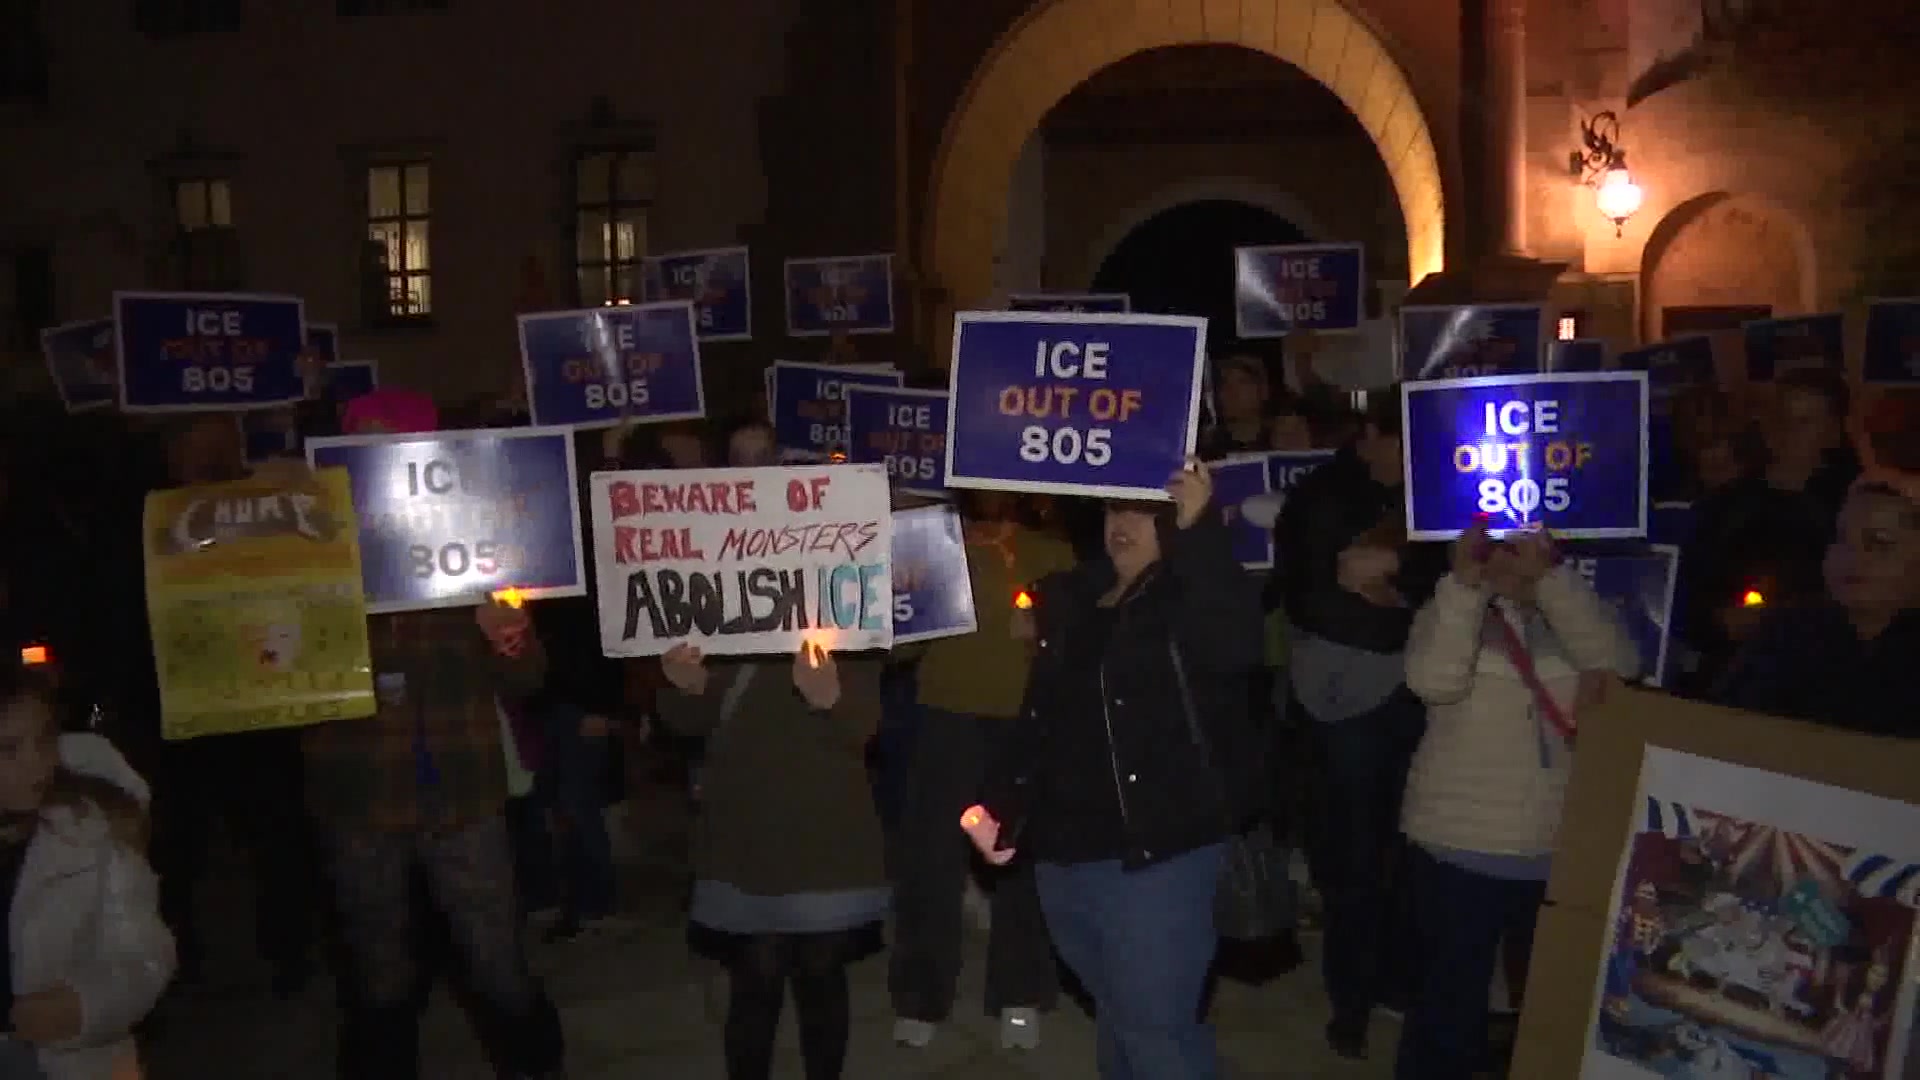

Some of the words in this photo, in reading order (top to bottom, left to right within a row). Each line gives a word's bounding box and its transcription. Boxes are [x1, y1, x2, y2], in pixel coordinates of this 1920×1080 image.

[185, 307, 243, 336] ICE
[1034, 339, 1111, 379] ICE
[181, 366, 255, 393] 805
[584, 377, 649, 408] 805
[816, 378, 849, 401] IC
[888, 403, 931, 430] ICE
[999, 384, 1080, 419] OUT
[1088, 387, 1142, 423] OF
[1484, 400, 1559, 436] ICE
[1019, 424, 1113, 466] 805
[1453, 441, 1531, 474] OUT
[1544, 440, 1593, 471] OF
[609, 479, 757, 521] BEWARE
[786, 475, 831, 513] OF
[1477, 476, 1571, 513] 805
[408, 541, 499, 578] 805
[615, 525, 704, 564] REAL
[717, 521, 878, 561] MONSTERS
[622, 567, 810, 641] ABOLISH
[816, 562, 885, 632] ICE
